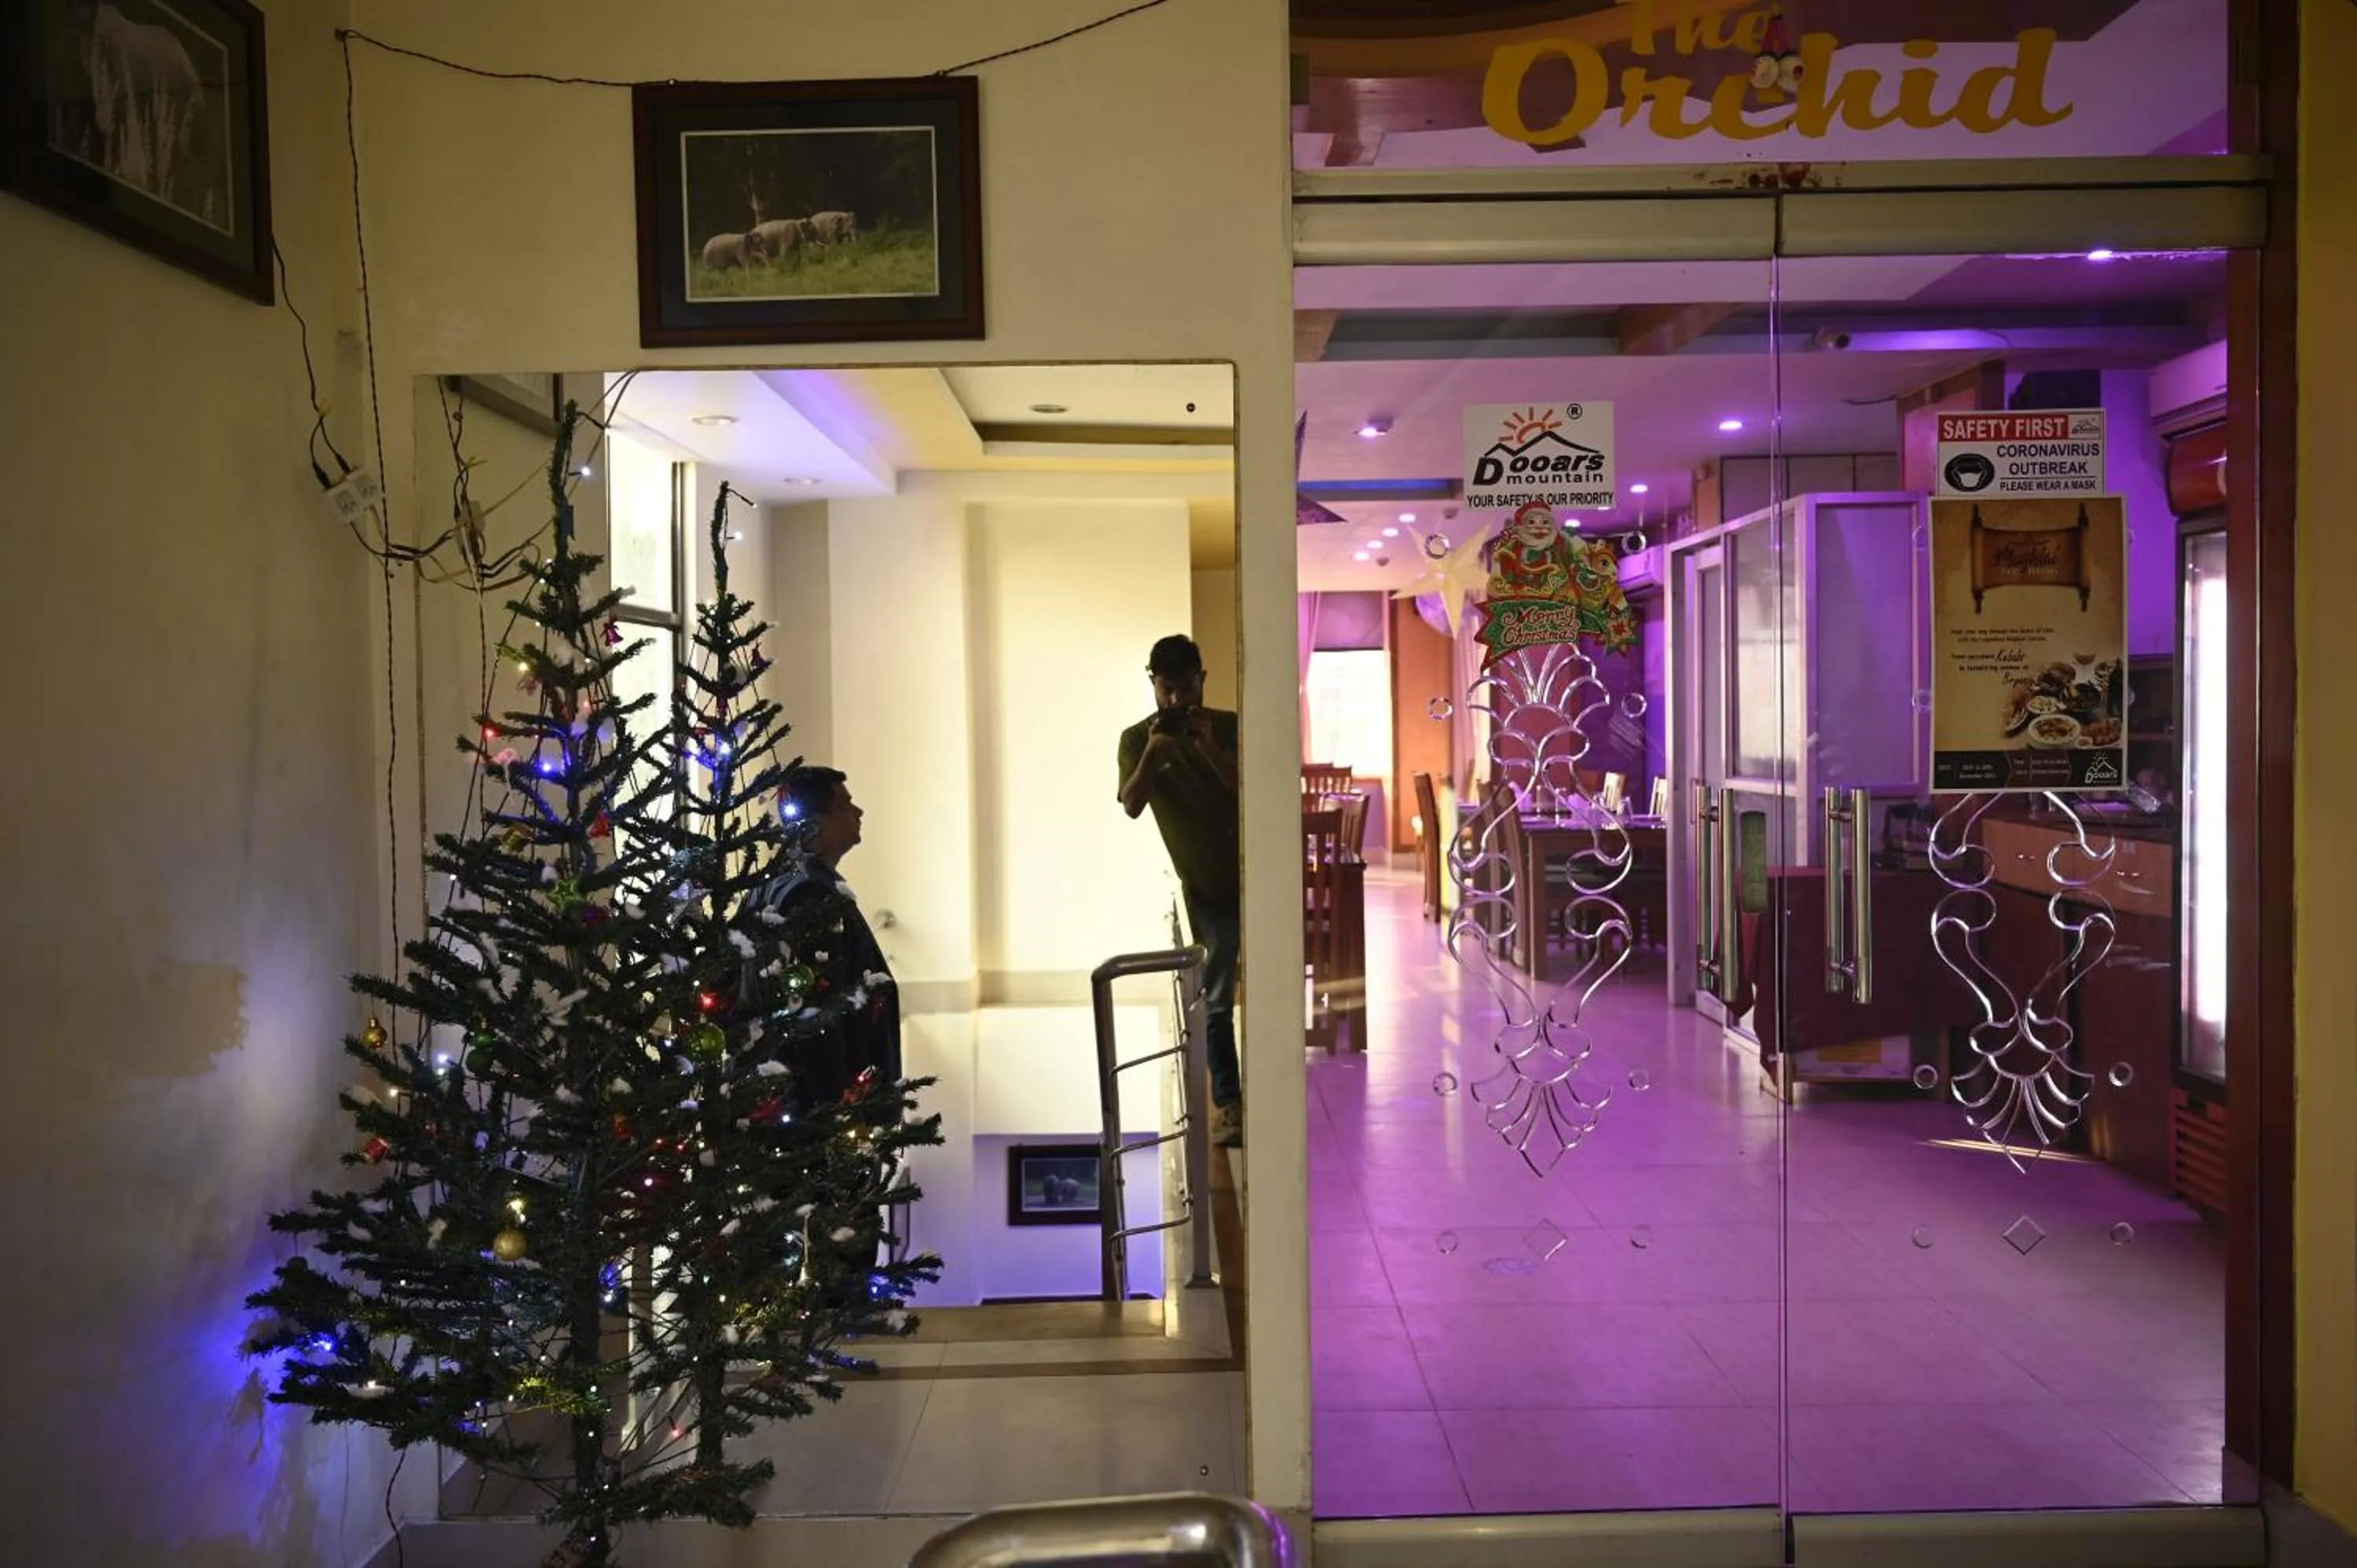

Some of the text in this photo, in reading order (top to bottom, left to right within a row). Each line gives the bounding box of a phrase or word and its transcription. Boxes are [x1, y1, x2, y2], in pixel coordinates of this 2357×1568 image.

[1482, 28, 2074, 145] Orchid
[1943, 417, 2066, 440] SAFETY FIRST
[1996, 443, 2100, 458] CORONAVIRUS
[1472, 454, 1605, 486] Dooars
[2009, 462, 2088, 475] OUTBREAK
[1506, 471, 1604, 485] mountain
[2000, 479, 2096, 491] PLEASE WEAR A MASK
[1467, 494, 1494, 507] YOUR
[1496, 493, 1532, 507] SAFETY
[1547, 493, 1567, 505] OUR
[1571, 492, 1613, 504] PRIORITY
[1502, 606, 1581, 628] Merry
[1501, 626, 1578, 646] Christmas
